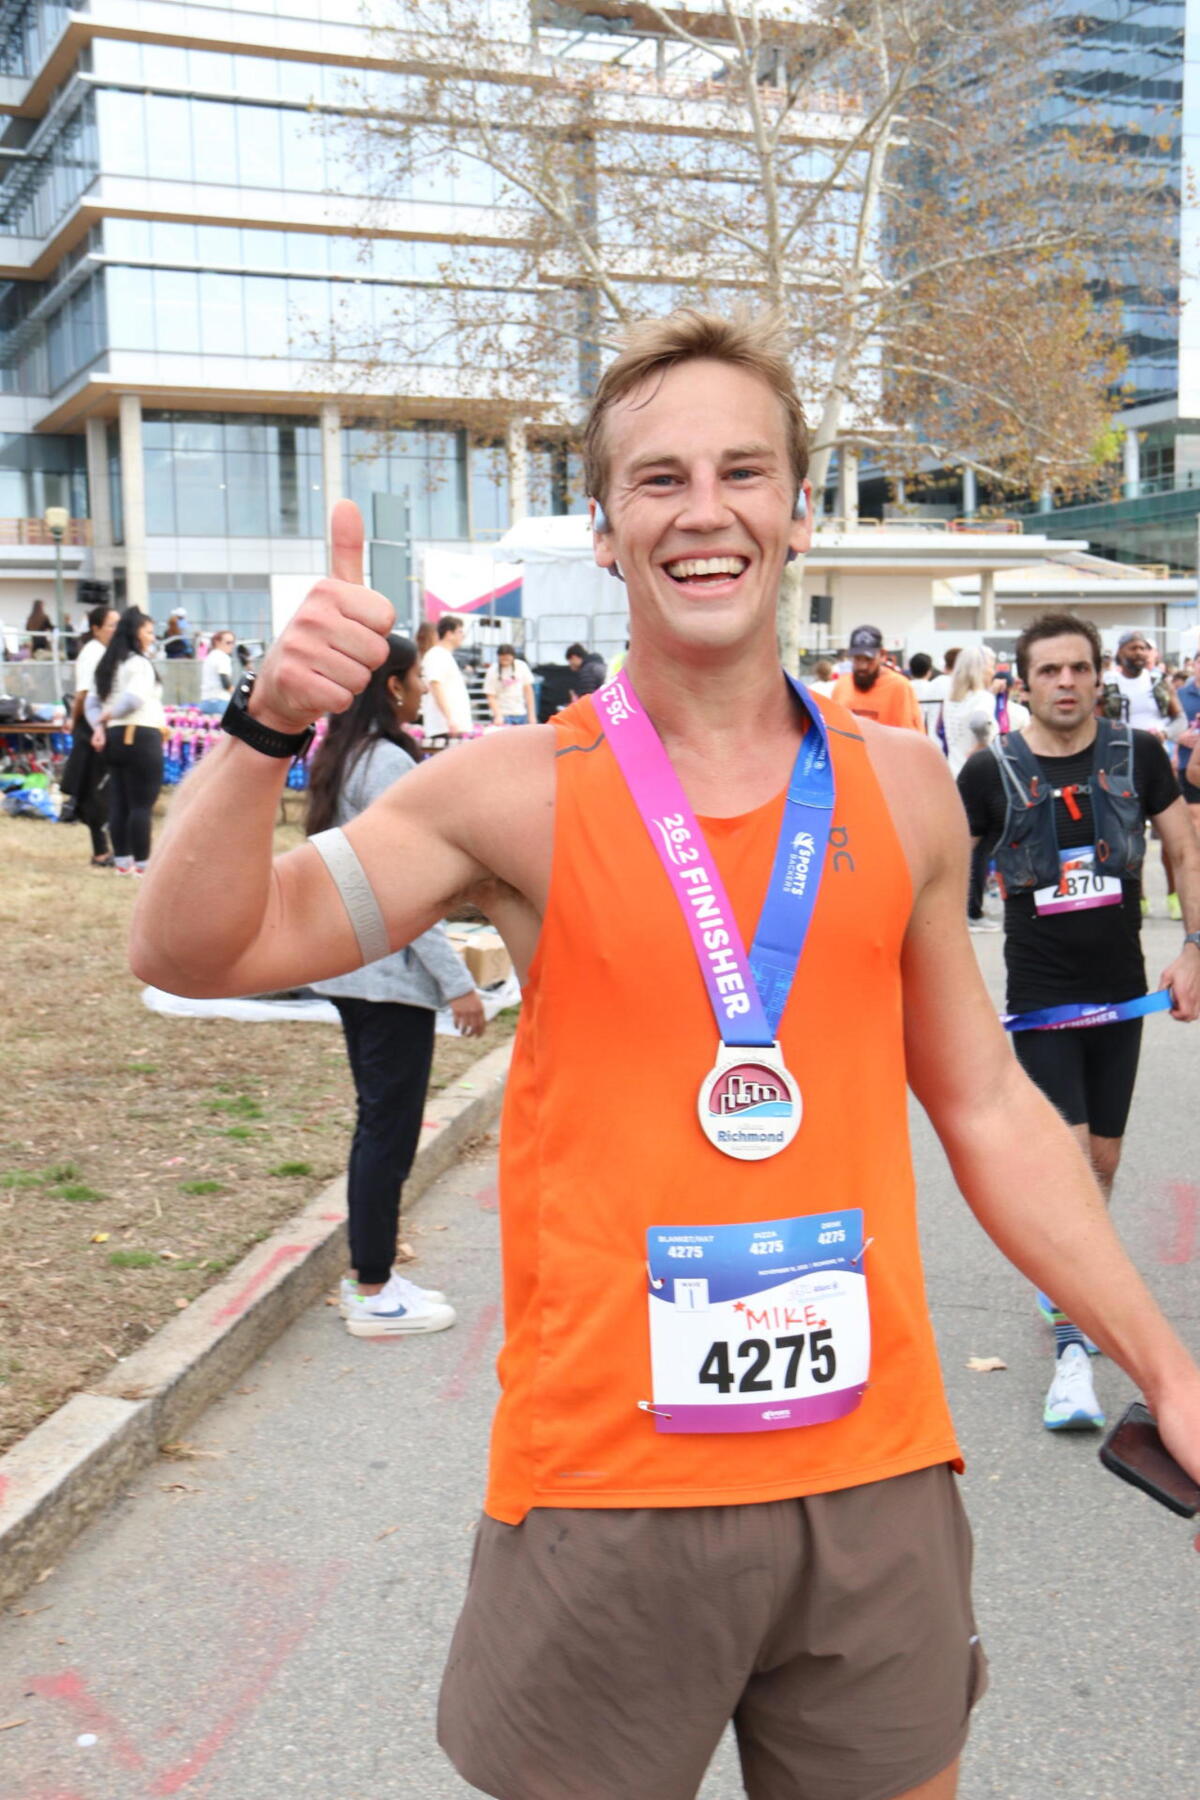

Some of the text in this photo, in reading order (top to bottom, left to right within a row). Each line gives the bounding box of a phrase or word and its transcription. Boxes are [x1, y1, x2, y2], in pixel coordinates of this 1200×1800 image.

[601, 686, 629, 726] 26.2
[662, 813, 700, 864] 26.2
[791, 849, 812, 897] SPORTS
[679, 866, 751, 1020] FINISHER
[717, 1129, 785, 1143] Richmond
[667, 1245, 704, 1259] 4275
[748, 1239, 784, 1255] 4275
[817, 1229, 846, 1245] 4275
[746, 1304, 817, 1331] MIKE
[698, 1328, 837, 1394] 4275
